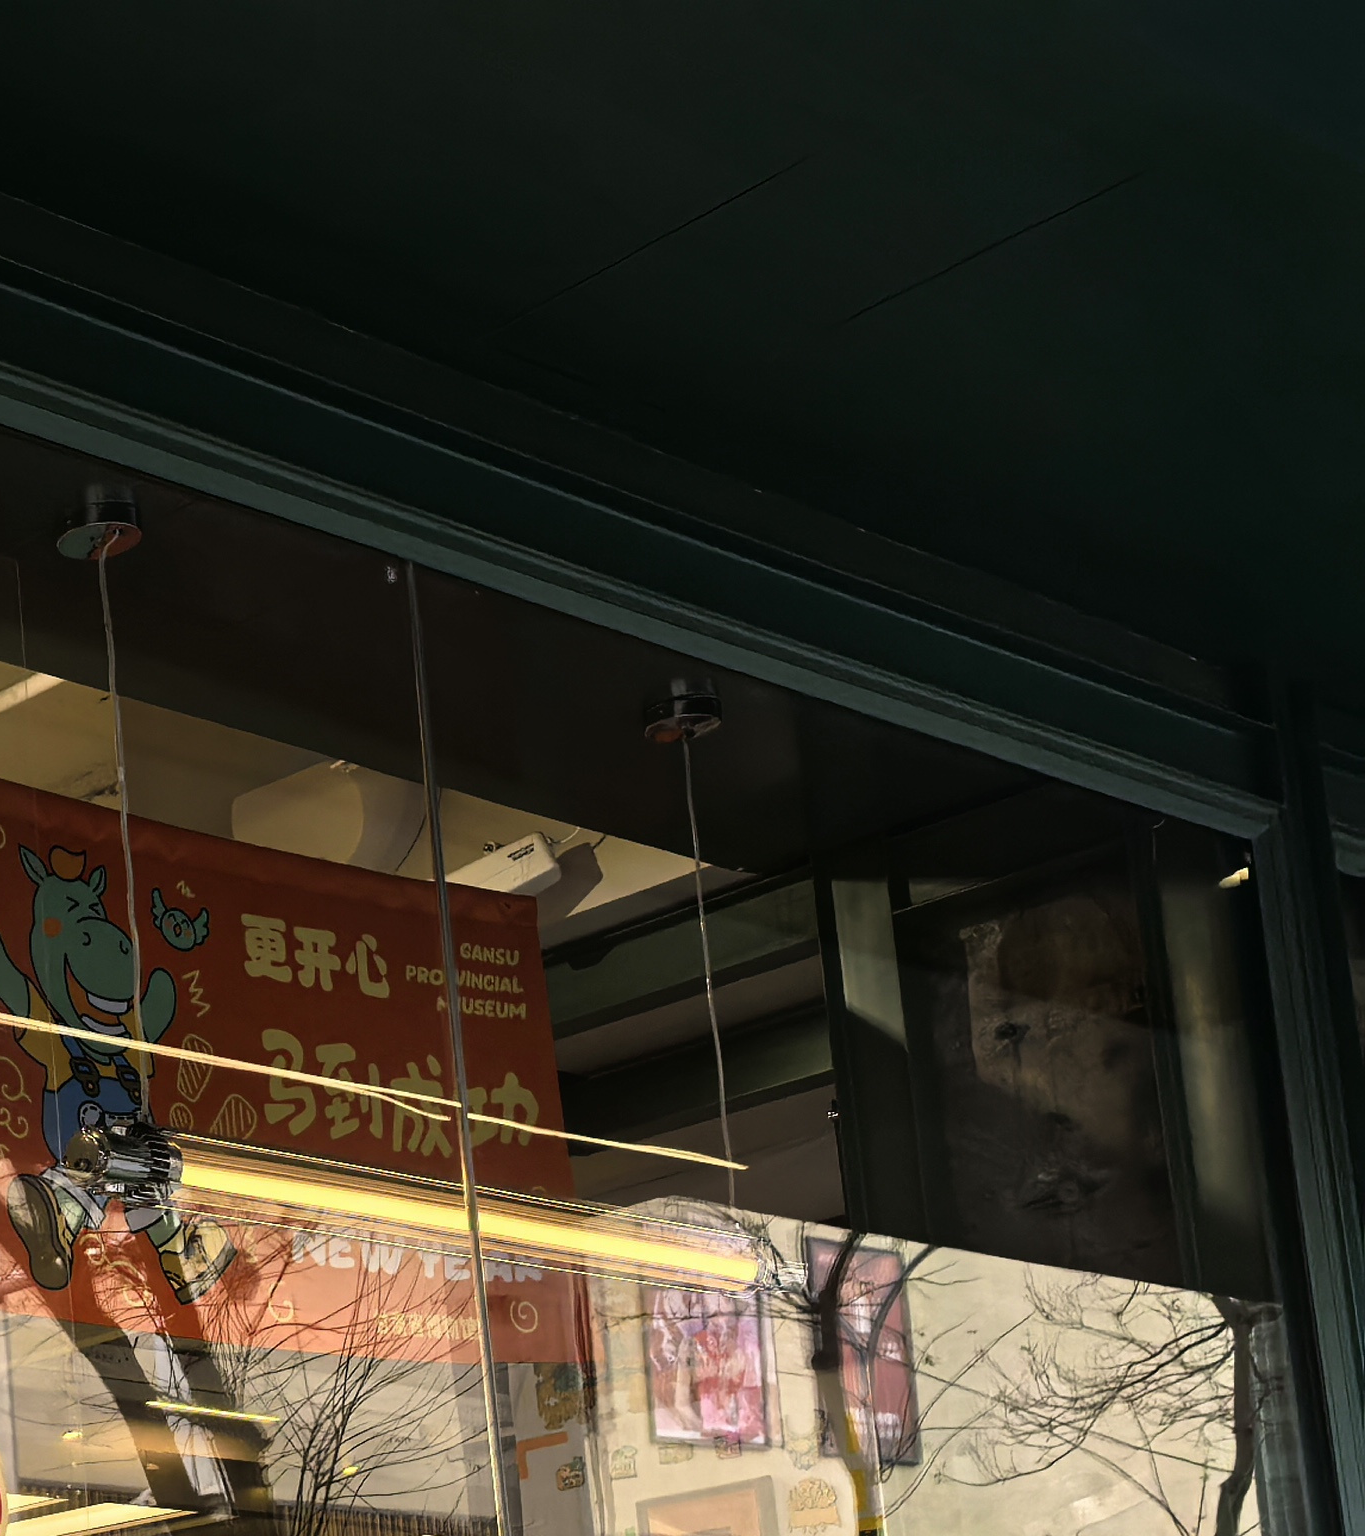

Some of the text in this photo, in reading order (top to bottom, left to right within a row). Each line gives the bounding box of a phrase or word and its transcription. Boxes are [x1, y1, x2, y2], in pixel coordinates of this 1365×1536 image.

[241, 913, 390, 998] 更开心
[459, 943, 520, 966] GANSU
[261, 1029, 539, 1158] 马到成功
